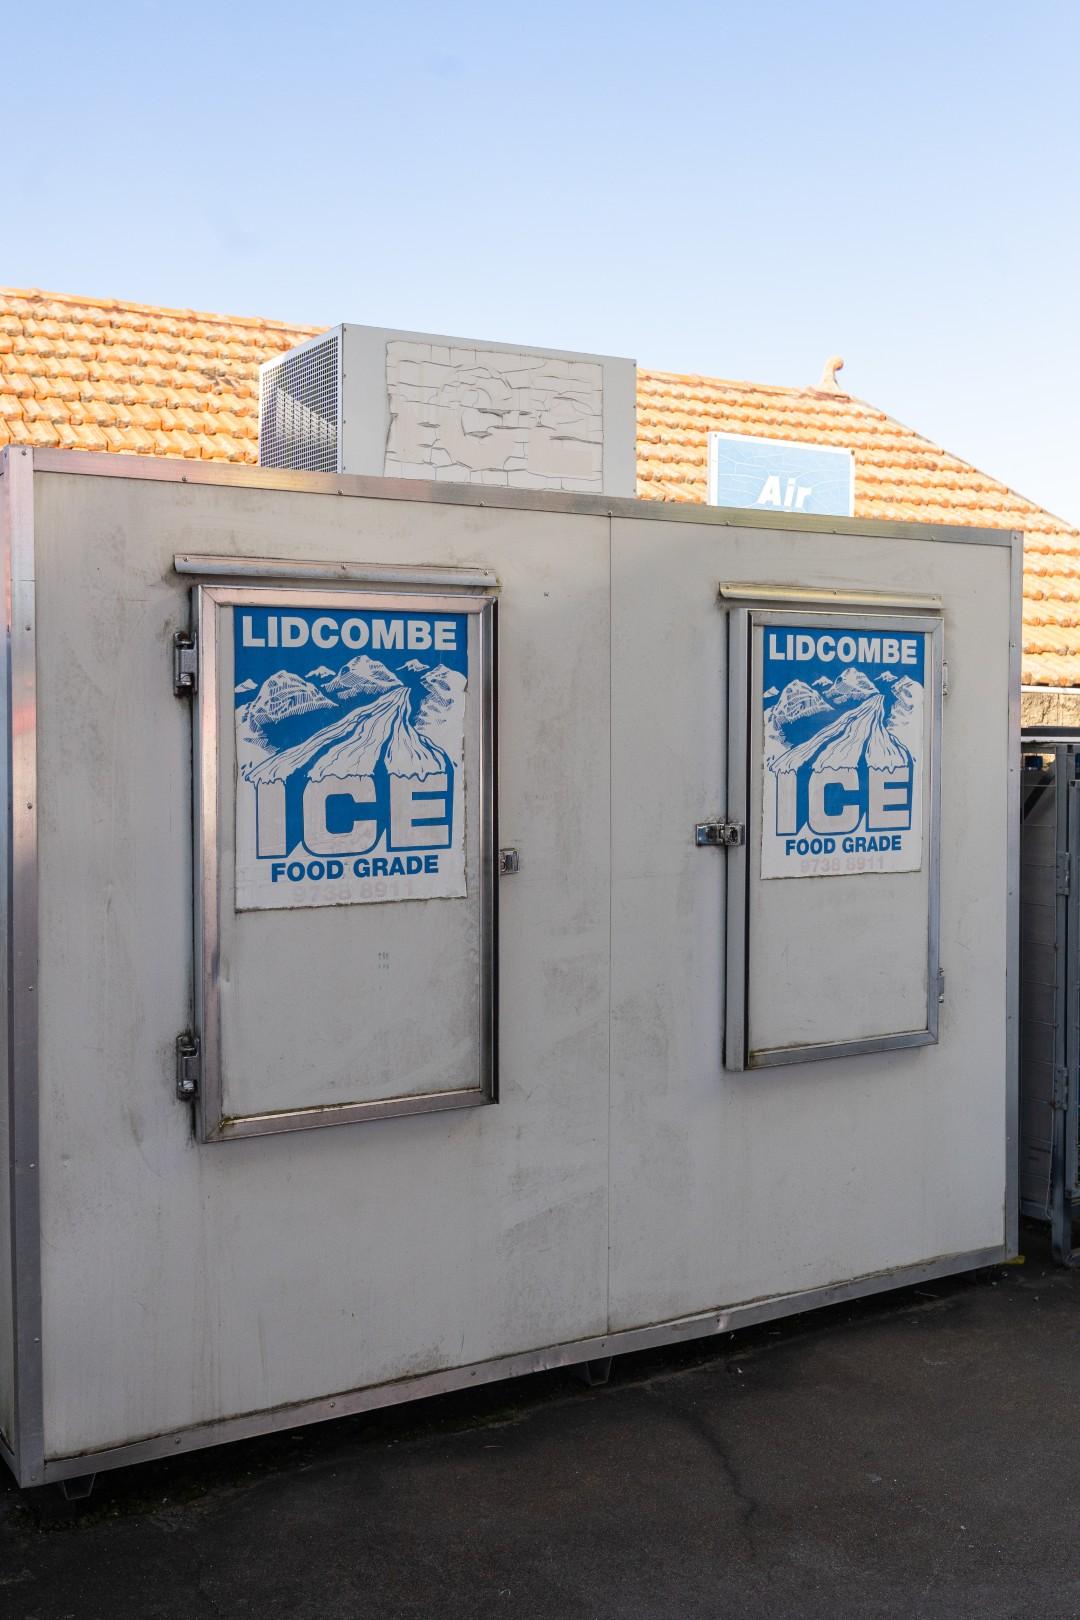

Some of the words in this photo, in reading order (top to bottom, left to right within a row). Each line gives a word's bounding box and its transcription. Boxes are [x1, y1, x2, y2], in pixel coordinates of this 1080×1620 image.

[757, 475, 812, 508] Air
[242, 615, 457, 651] LIDCOMBE
[769, 634, 917, 664] LIDCOMBE
[775, 763, 914, 836] ICE
[256, 772, 454, 859] ICE
[785, 838, 836, 856] FOOD
[842, 835, 902, 853] GRADE
[271, 859, 344, 882] FOOD
[353, 855, 439, 876] GRADE
[800, 857, 841, 874] 9738
[846, 855, 884, 872] 8911
